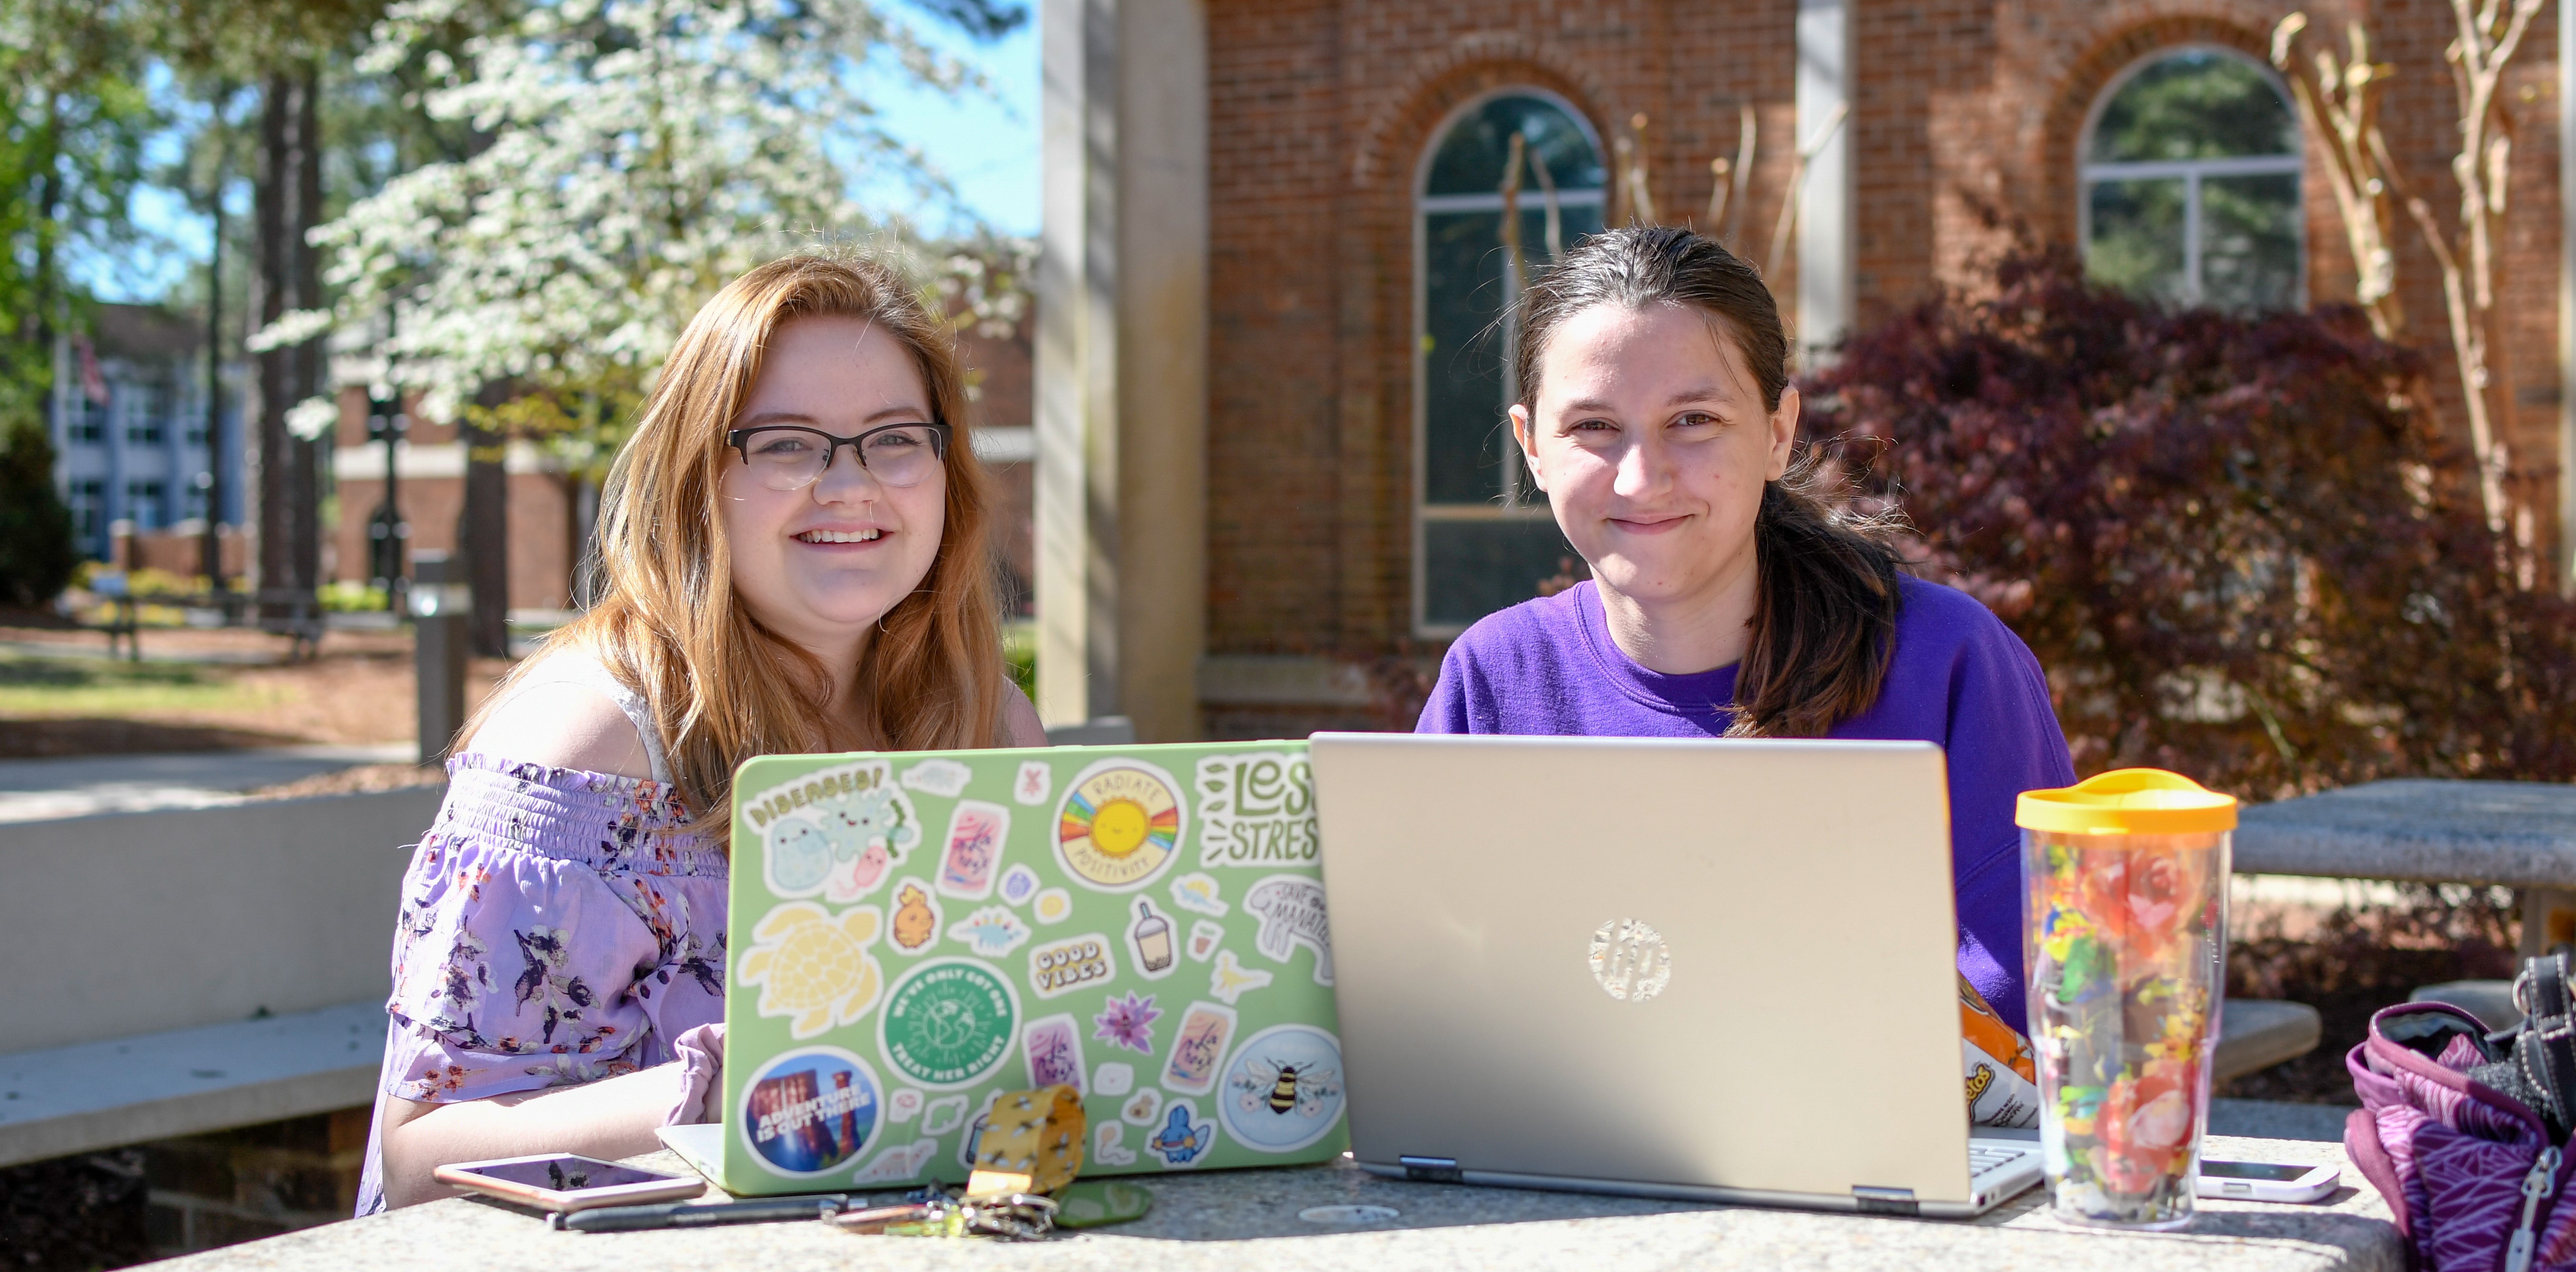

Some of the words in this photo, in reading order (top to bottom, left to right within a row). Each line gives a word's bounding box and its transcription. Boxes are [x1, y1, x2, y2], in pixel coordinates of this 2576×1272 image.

[749, 767, 882, 827] DISEASES!
[1092, 773, 1163, 803] RADIATE
[1235, 760, 1315, 816] LeS
[1229, 817, 1319, 860] STRES
[1073, 847, 1149, 878] POSITIVITY
[1036, 959, 1107, 991] VIBES
[1037, 941, 1100, 971] GOOD
[893, 978, 924, 1017] WE'VE
[925, 968, 964, 984] ONLY
[966, 971, 993, 991] GOT
[989, 988, 1008, 1017] ONE
[892, 1042, 932, 1078] TREAT
[933, 1067, 966, 1081] HER
[967, 1034, 1004, 1074] RIGHT
[758, 1082, 862, 1131] ADVENTURE
[1965, 1064, 1992, 1104] etos
[756, 1122, 776, 1143] IS
[776, 1112, 814, 1136] OUT
[814, 1091, 872, 1122] THERE
